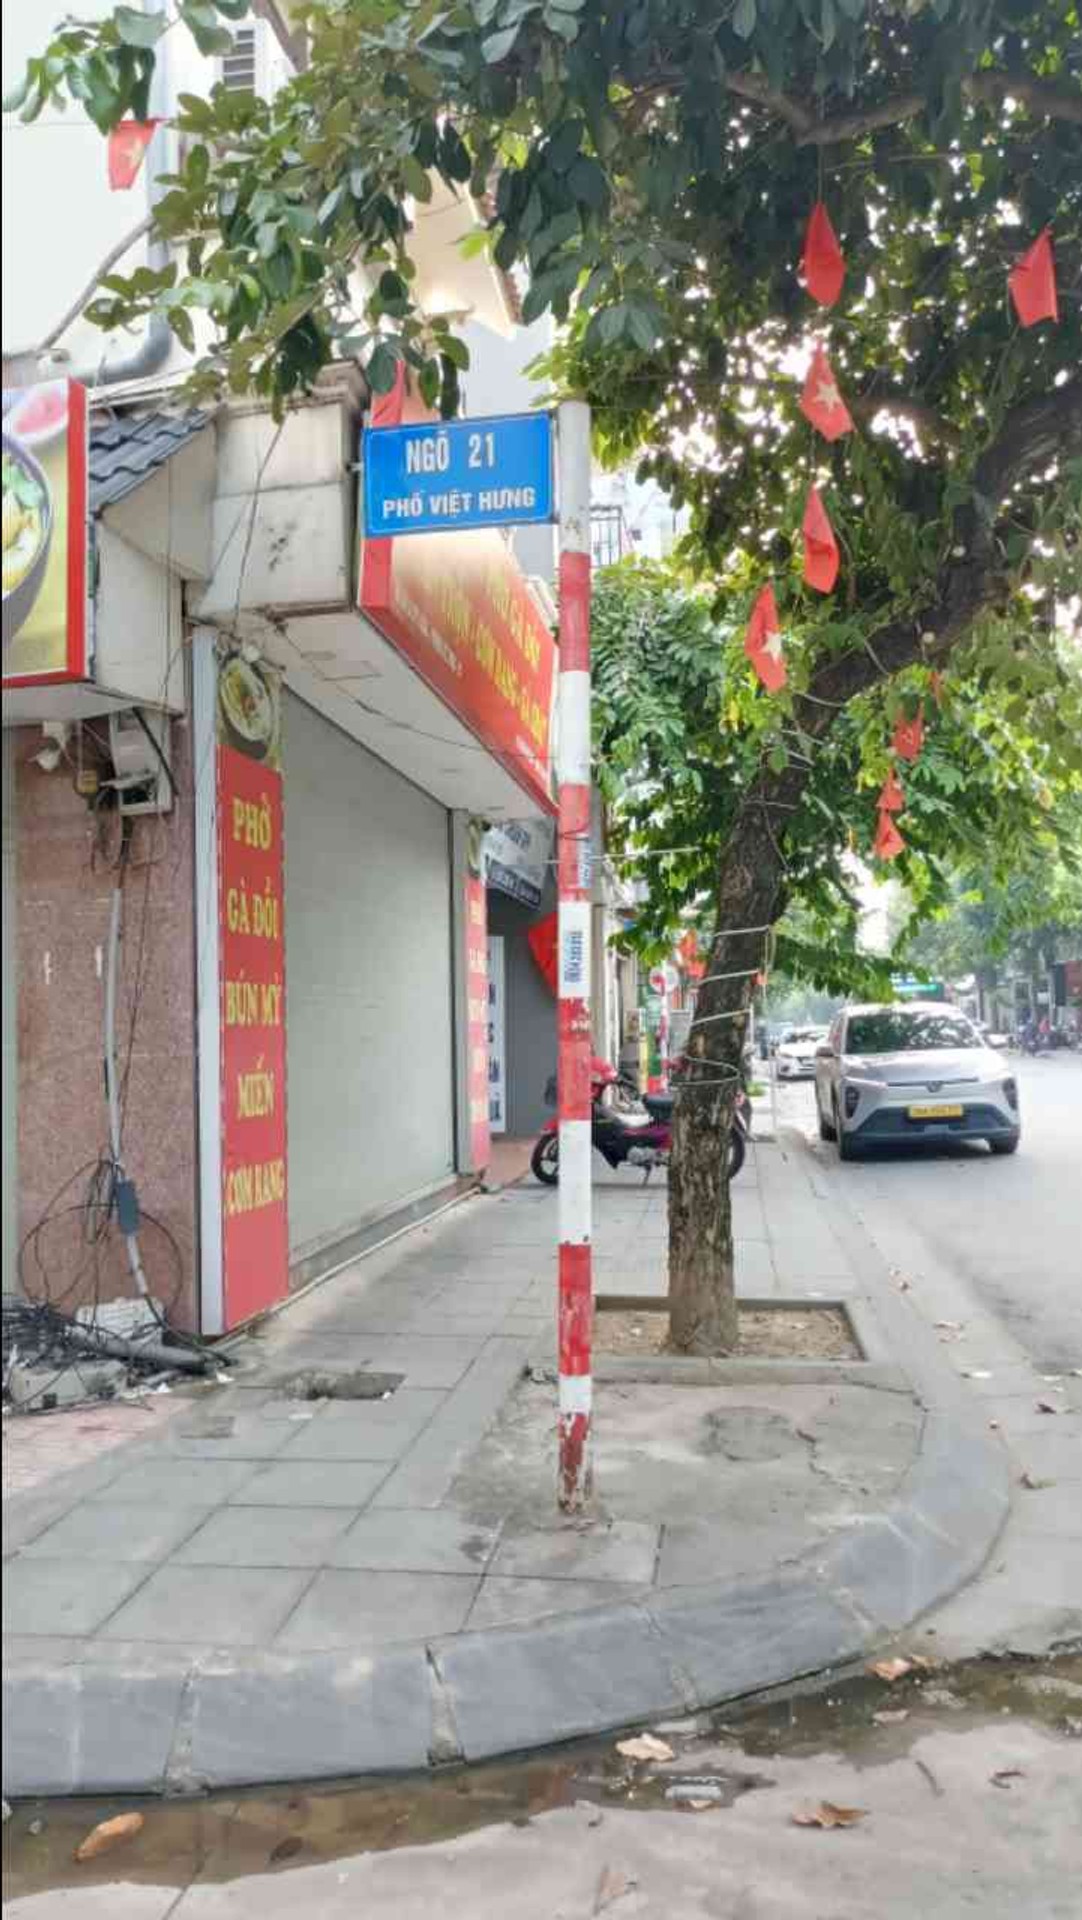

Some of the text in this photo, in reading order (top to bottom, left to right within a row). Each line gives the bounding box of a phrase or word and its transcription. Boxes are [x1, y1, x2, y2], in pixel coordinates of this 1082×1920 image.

[406, 430, 494, 473] NGÕ 21
[383, 486, 536, 519] PHỐ VIỆT HƯNG
[226, 968, 258, 1027] BÚN
